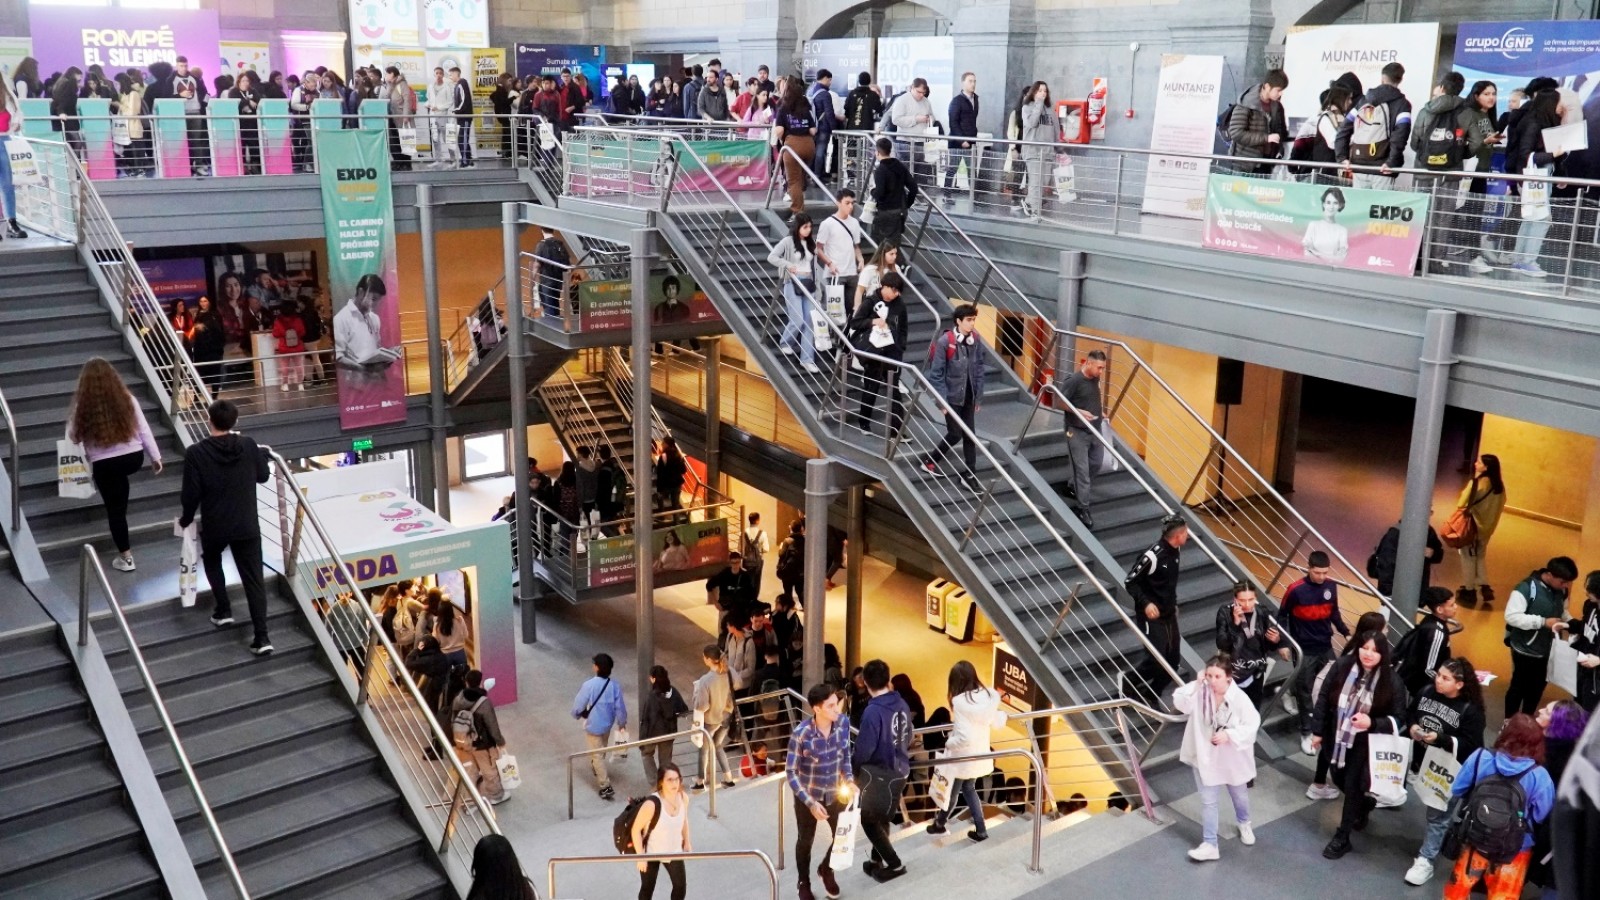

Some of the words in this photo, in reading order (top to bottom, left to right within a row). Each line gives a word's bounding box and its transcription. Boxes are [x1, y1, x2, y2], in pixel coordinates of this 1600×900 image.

[82, 24, 174, 48] ROMPÉ
[1465, 37, 1499, 48] grupo
[1504, 37, 1534, 48] GNP
[84, 47, 105, 66] EL
[108, 48, 177, 67] SILENCIO
[1322, 49, 1398, 62] MUNTANER
[803, 58, 818, 68] que
[1163, 82, 1215, 94] MUNTANER
[337, 167, 378, 181] EXPO
[1222, 182, 1232, 192] TU
[1247, 185, 1285, 198] LABURO
[1219, 207, 1233, 216] Las
[1233, 208, 1294, 224] oportunidades
[1369, 204, 1414, 222] EXPO
[350, 218, 383, 227] CAMINO
[1217, 219, 1233, 229] que
[1234, 219, 1262, 231] buscás
[340, 229, 365, 238] HACIA
[366, 229, 378, 237] TU
[1366, 222, 1410, 239] JOVEN
[340, 239, 380, 250] PRÓXIMO
[341, 251, 375, 260] LABURO
[590, 301, 597, 309] El
[598, 300, 623, 308] camino
[590, 309, 618, 318] próximo
[698, 526, 721, 539] EXPO
[408, 539, 472, 559] OPORTUNIDADES
[409, 555, 452, 571] AMENAZAS
[600, 553, 633, 565] Encontrá
[316, 553, 399, 590] FODA
[1375, 751, 1404, 764] EXPO
[1428, 759, 1455, 785] EXPO
